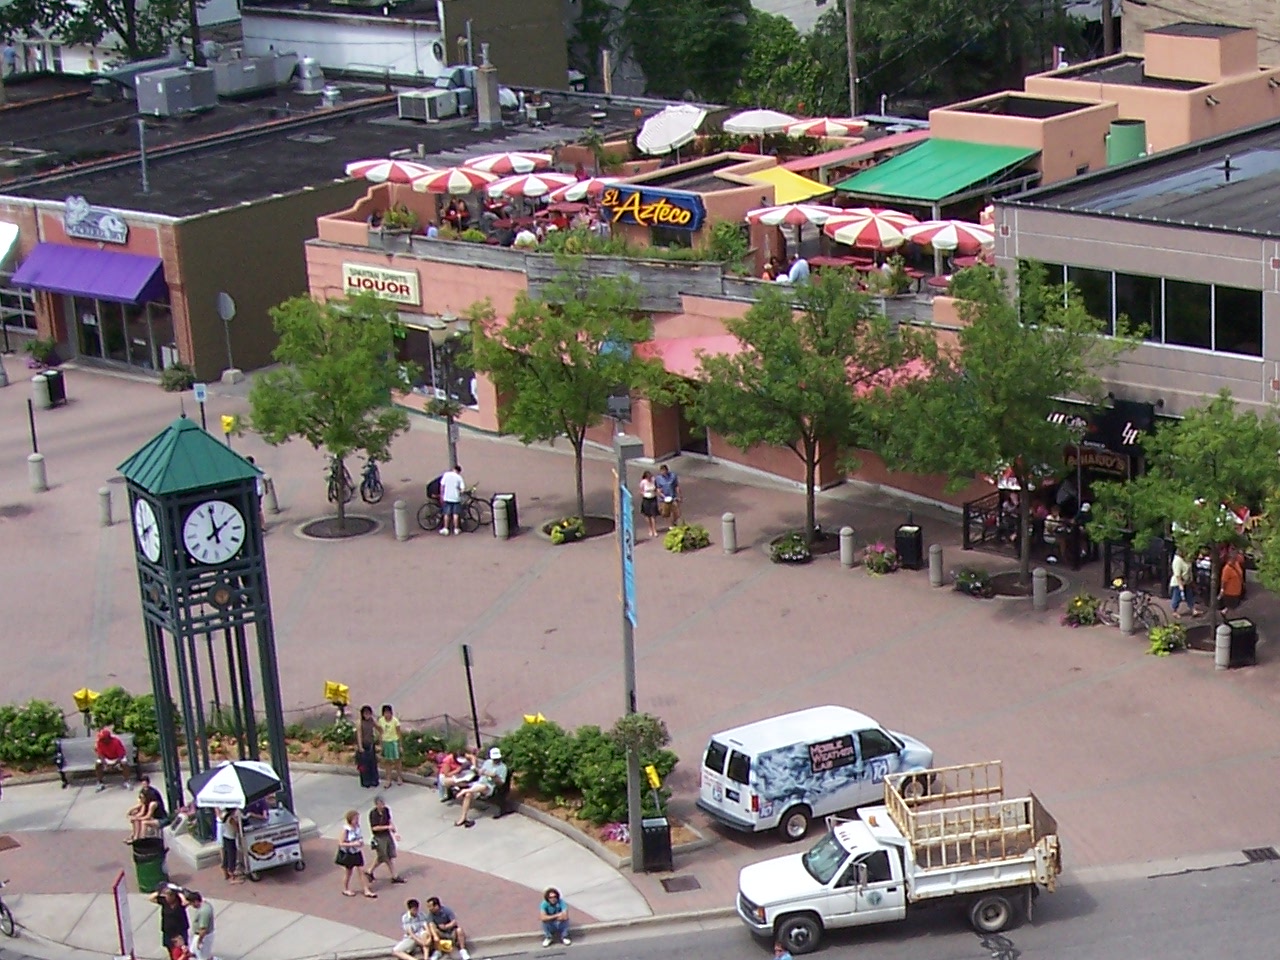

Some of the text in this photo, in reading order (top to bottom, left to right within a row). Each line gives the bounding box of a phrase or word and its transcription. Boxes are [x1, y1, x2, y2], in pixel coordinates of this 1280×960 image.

[612, 191, 692, 227] Azteco
[347, 276, 410, 296] LIQUOR
[813, 760, 834, 772] LAB
